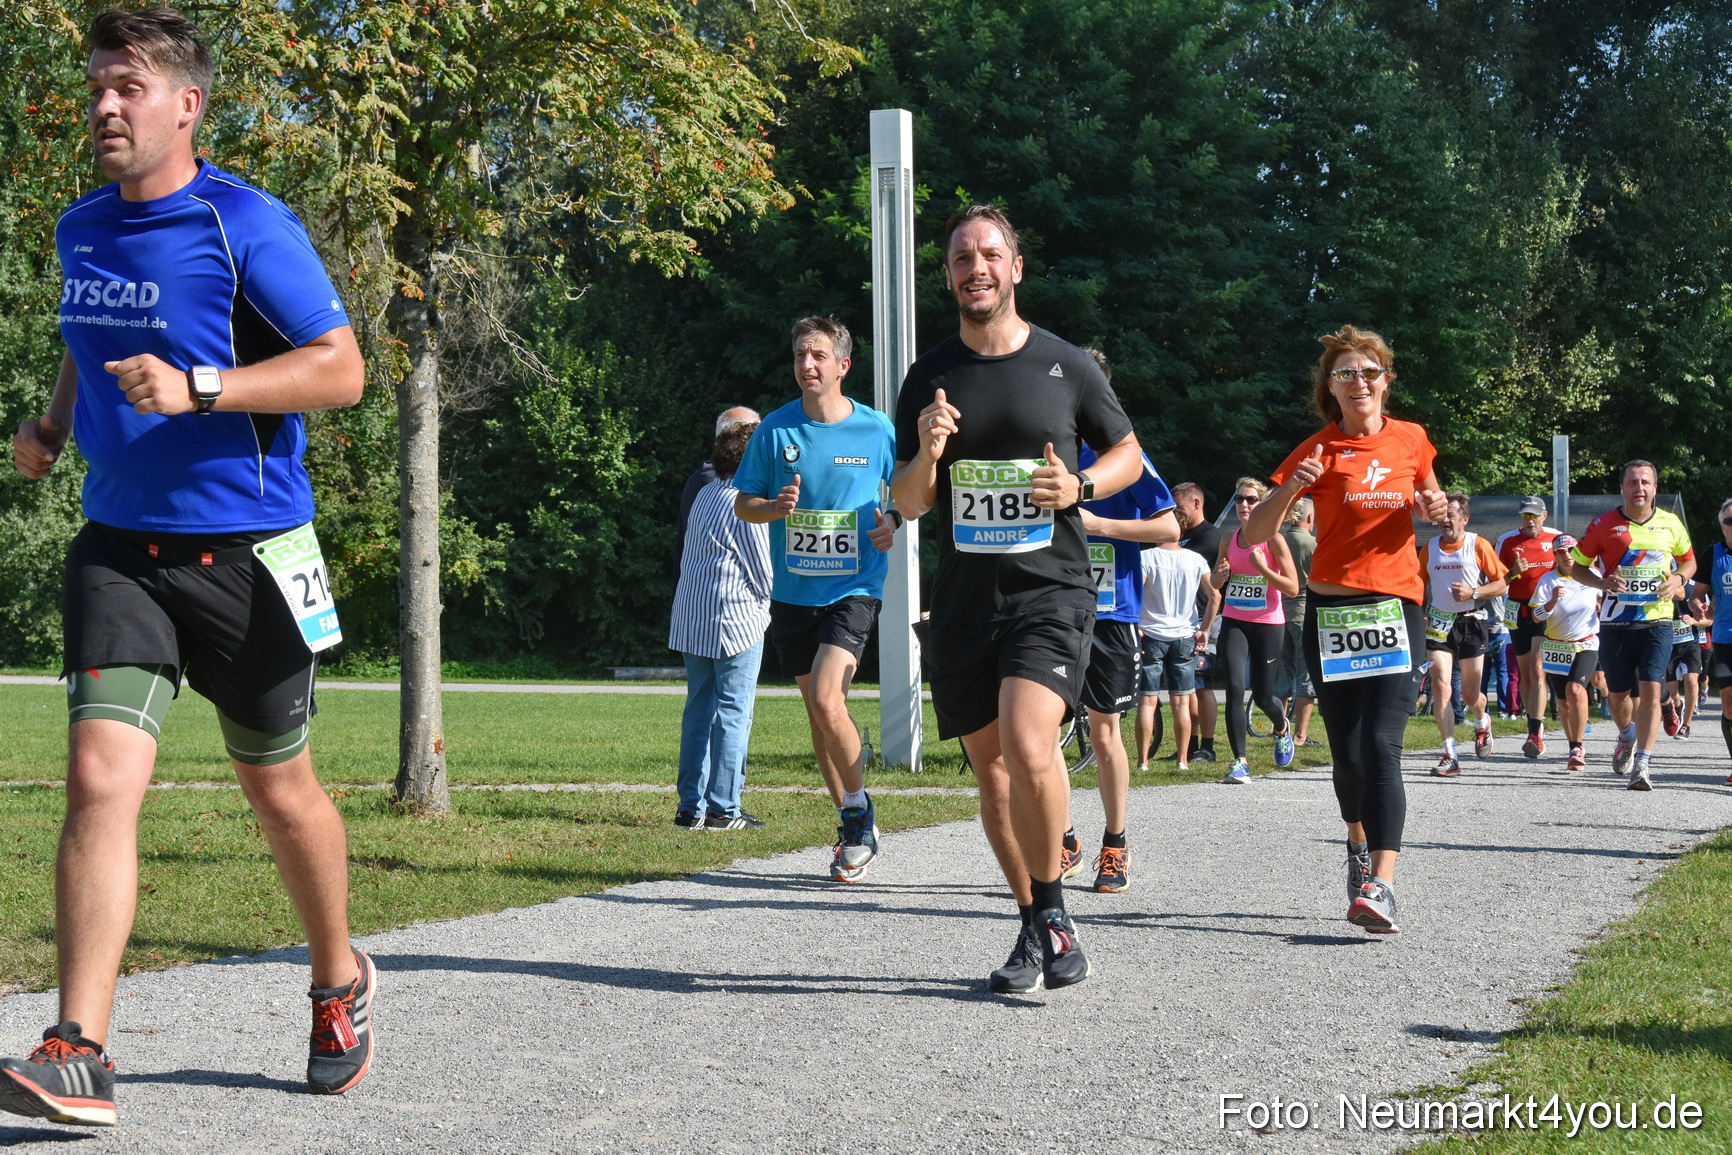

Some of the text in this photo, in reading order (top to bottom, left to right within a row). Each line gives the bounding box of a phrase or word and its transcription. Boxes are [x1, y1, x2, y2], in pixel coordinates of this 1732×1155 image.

[834, 457, 868, 465] BOCK
[1343, 491, 1402, 504] funrunners
[962, 493, 1042, 520] 2185
[1361, 500, 1409, 509] neumarkt
[791, 512, 851, 528] BOCK
[973, 527, 1028, 542] ANDRÉ
[793, 532, 849, 554] 2216
[797, 558, 843, 569] JOHANN
[1620, 568, 1657, 577] BOCK
[1231, 575, 1264, 584] BOCK
[1230, 585, 1262, 598] 2788
[1324, 603, 1398, 626] BOCK
[1329, 627, 1398, 654] 3008
[1542, 641, 1576, 652] BOCK
[1350, 657, 1382, 669] GABI
[1544, 652, 1572, 664] 2808
[1115, 695, 1132, 705] JAKO
